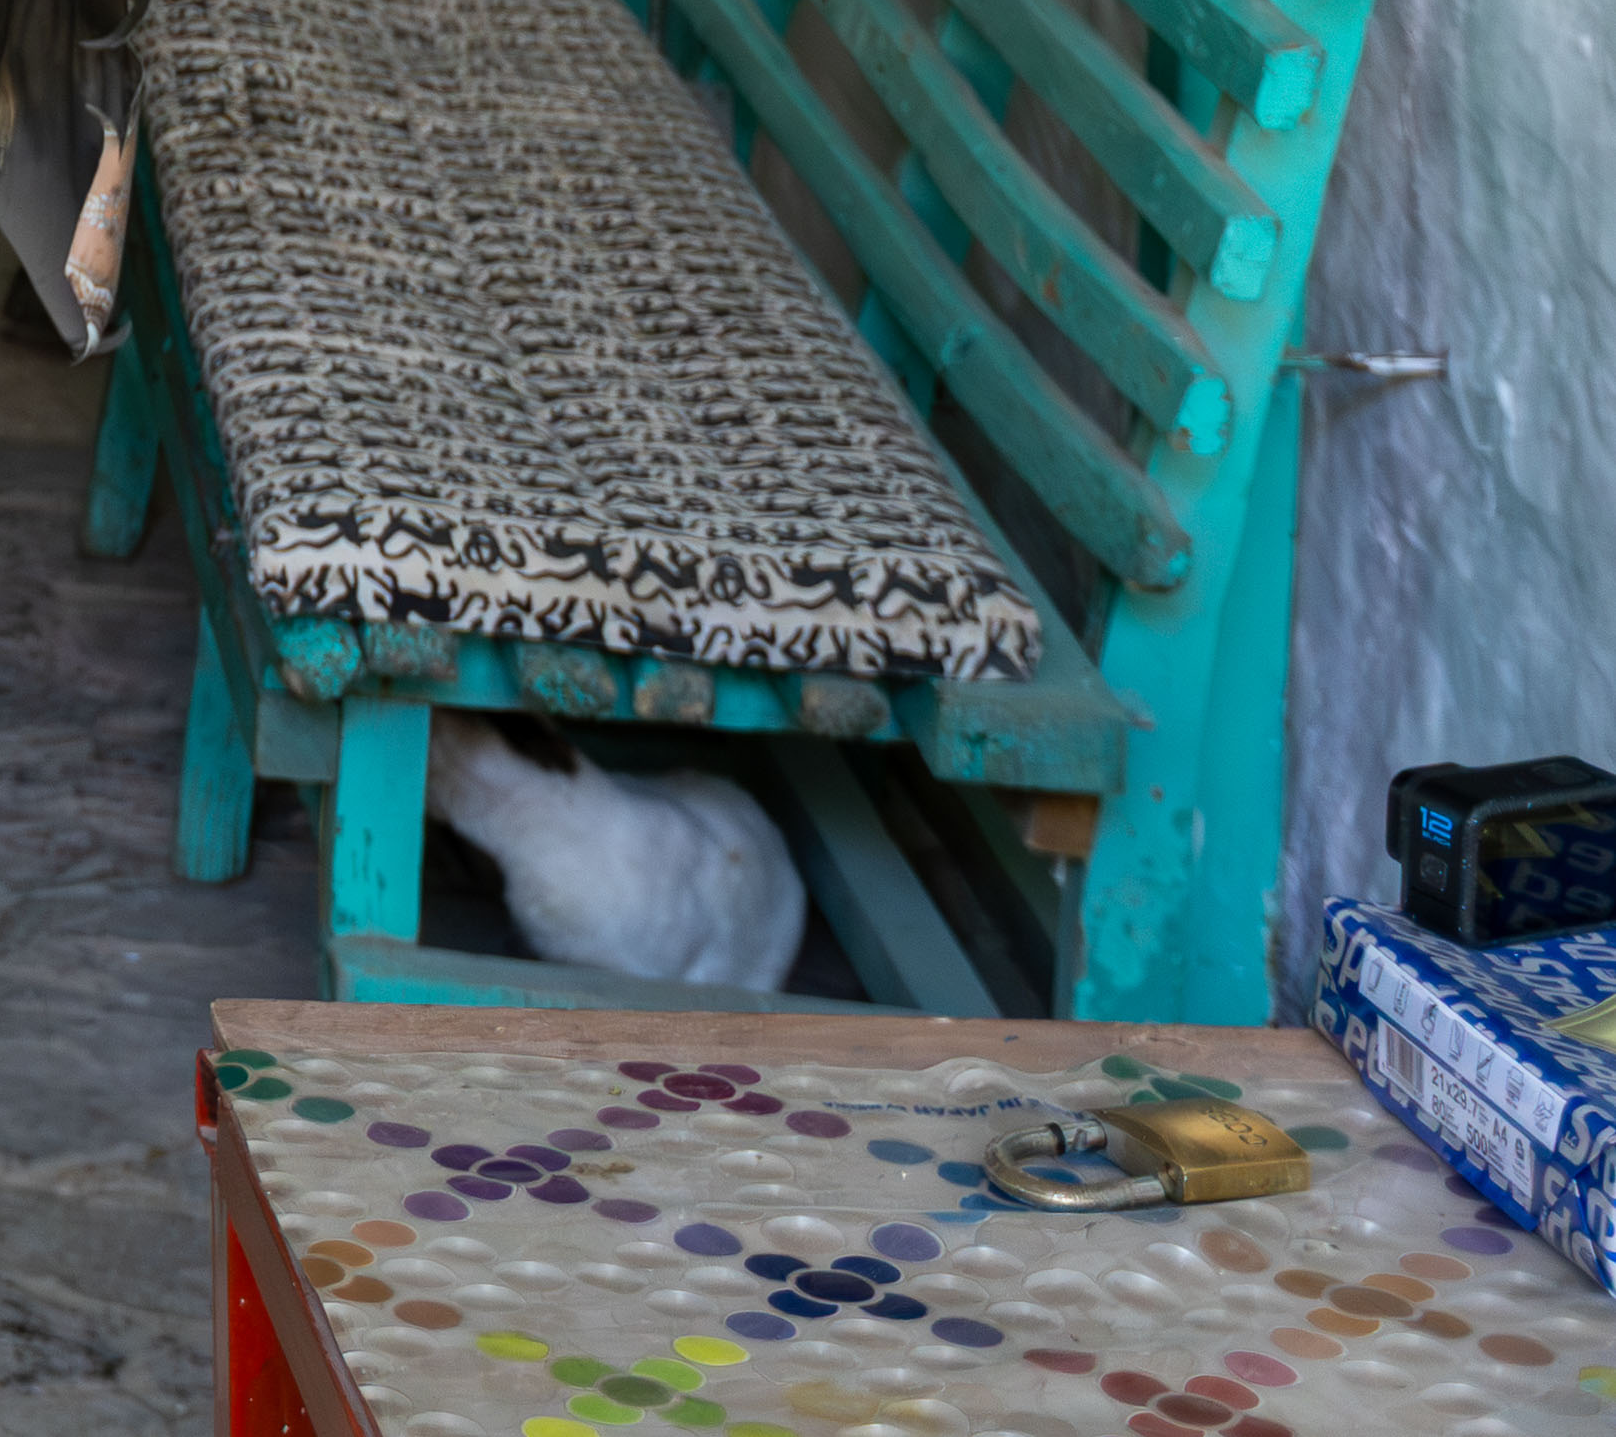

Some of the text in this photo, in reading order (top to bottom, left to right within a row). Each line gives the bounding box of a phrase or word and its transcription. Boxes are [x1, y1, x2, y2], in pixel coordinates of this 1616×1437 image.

[1419, 805, 1454, 839] 12
[1432, 1094, 1446, 1121] 80
[1466, 1122, 1488, 1156] 500
